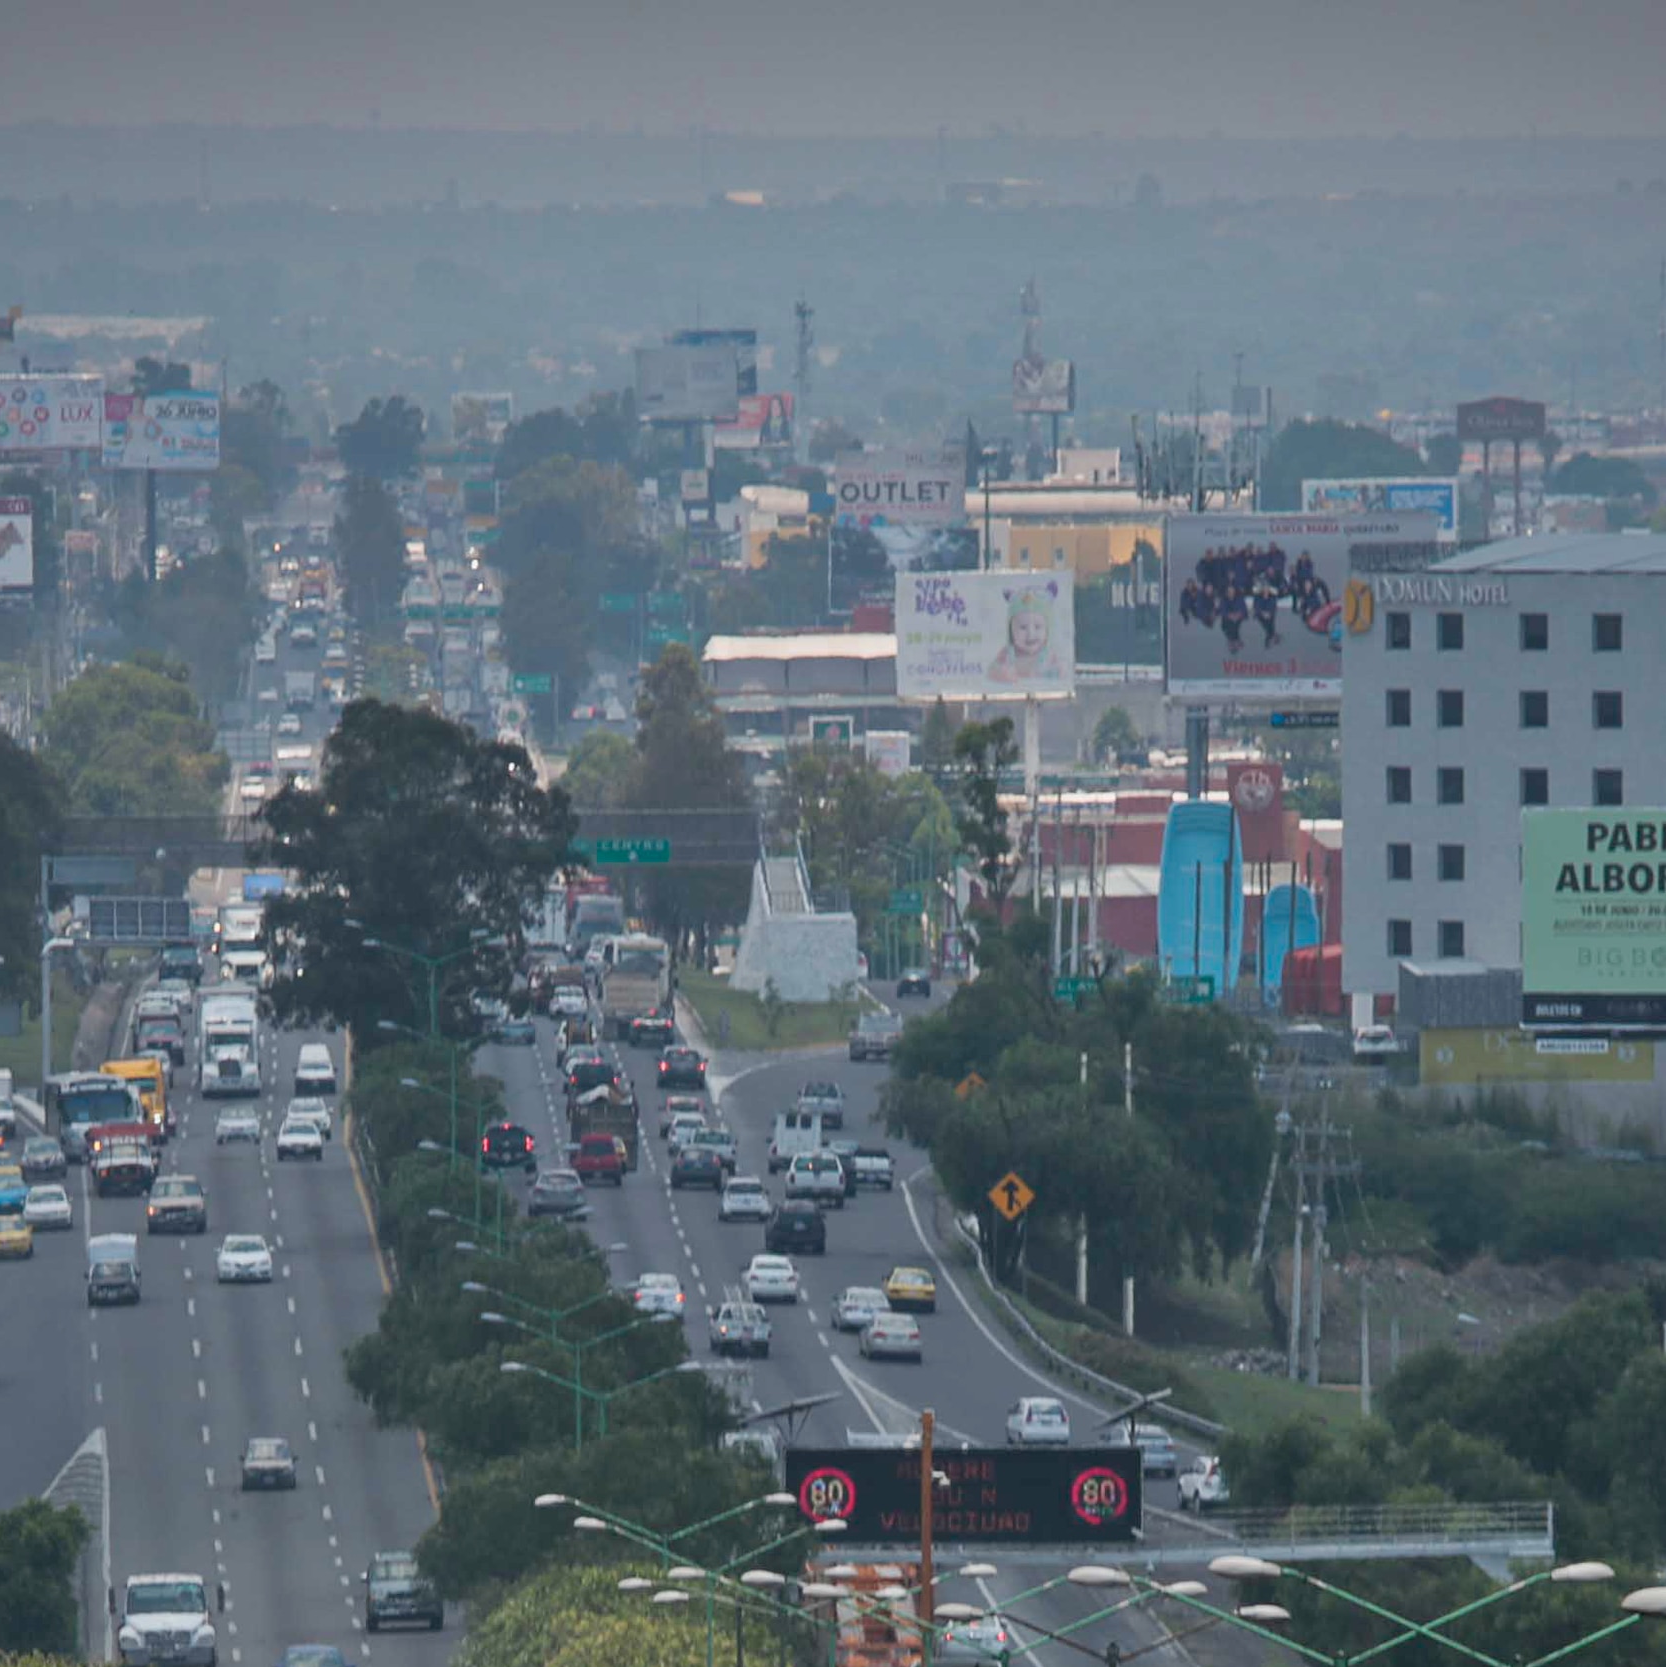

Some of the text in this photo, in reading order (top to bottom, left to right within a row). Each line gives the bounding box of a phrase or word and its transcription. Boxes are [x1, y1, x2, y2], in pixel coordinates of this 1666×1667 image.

[840, 480, 951, 503] OUTLET
[1375, 576, 1509, 604] DOMUN HOTEL
[1577, 947, 1623, 967] BIG
[811, 1478, 844, 1506] 80
[1082, 1479, 1116, 1506] 80
